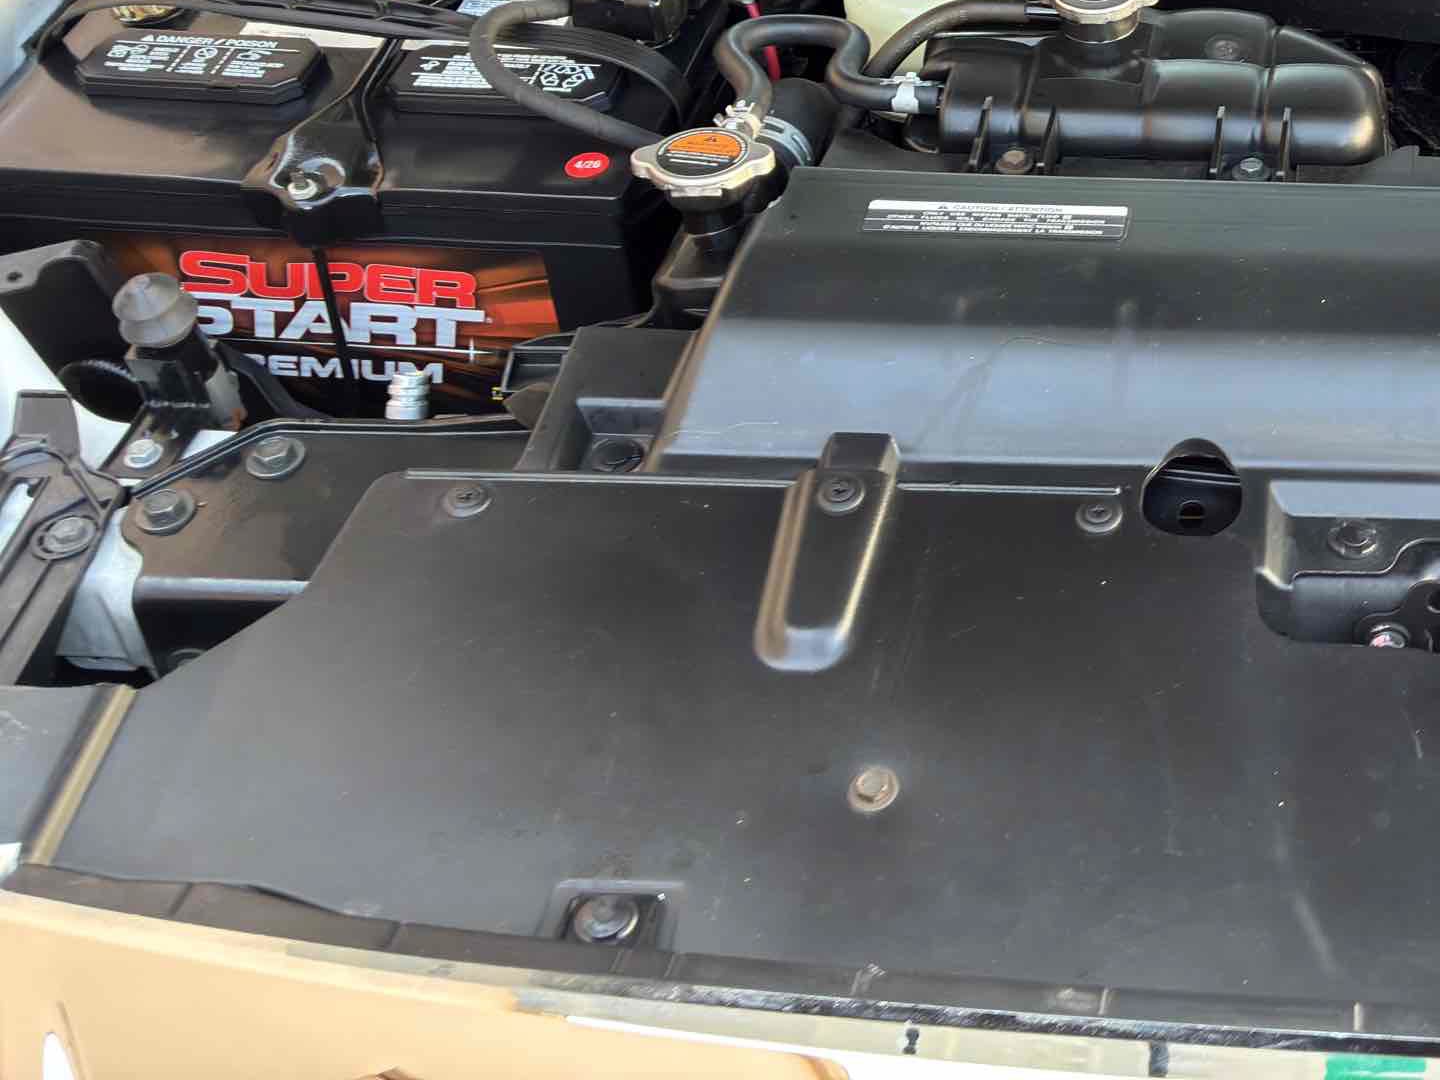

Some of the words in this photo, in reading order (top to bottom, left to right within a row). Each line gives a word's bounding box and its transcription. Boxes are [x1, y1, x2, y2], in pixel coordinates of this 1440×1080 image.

[156, 34, 214, 46] DANGER
[223, 38, 279, 49] POISON
[180, 250, 477, 309] SUPER
